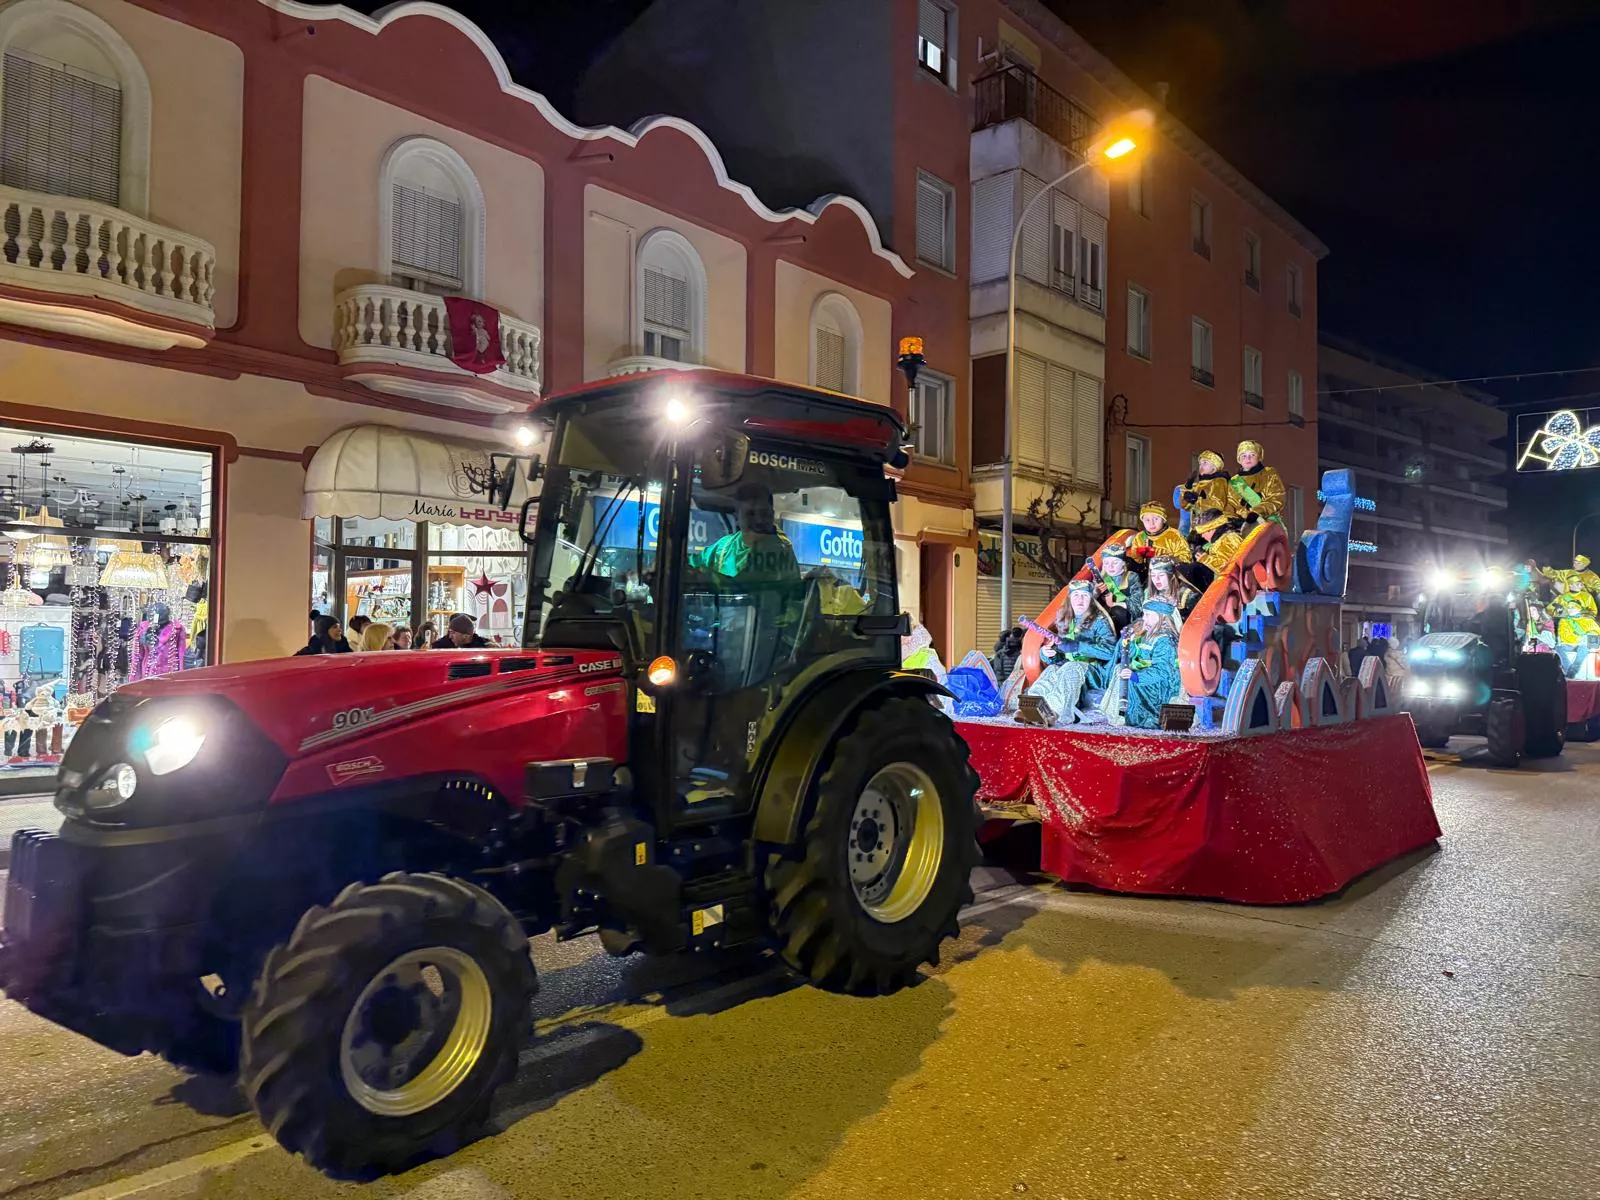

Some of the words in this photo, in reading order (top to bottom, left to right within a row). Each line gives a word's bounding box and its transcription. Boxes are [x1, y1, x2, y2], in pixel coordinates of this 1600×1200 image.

[408, 499, 456, 518] María
[820, 529, 863, 559] Gotta
[579, 660, 612, 673] CASE
